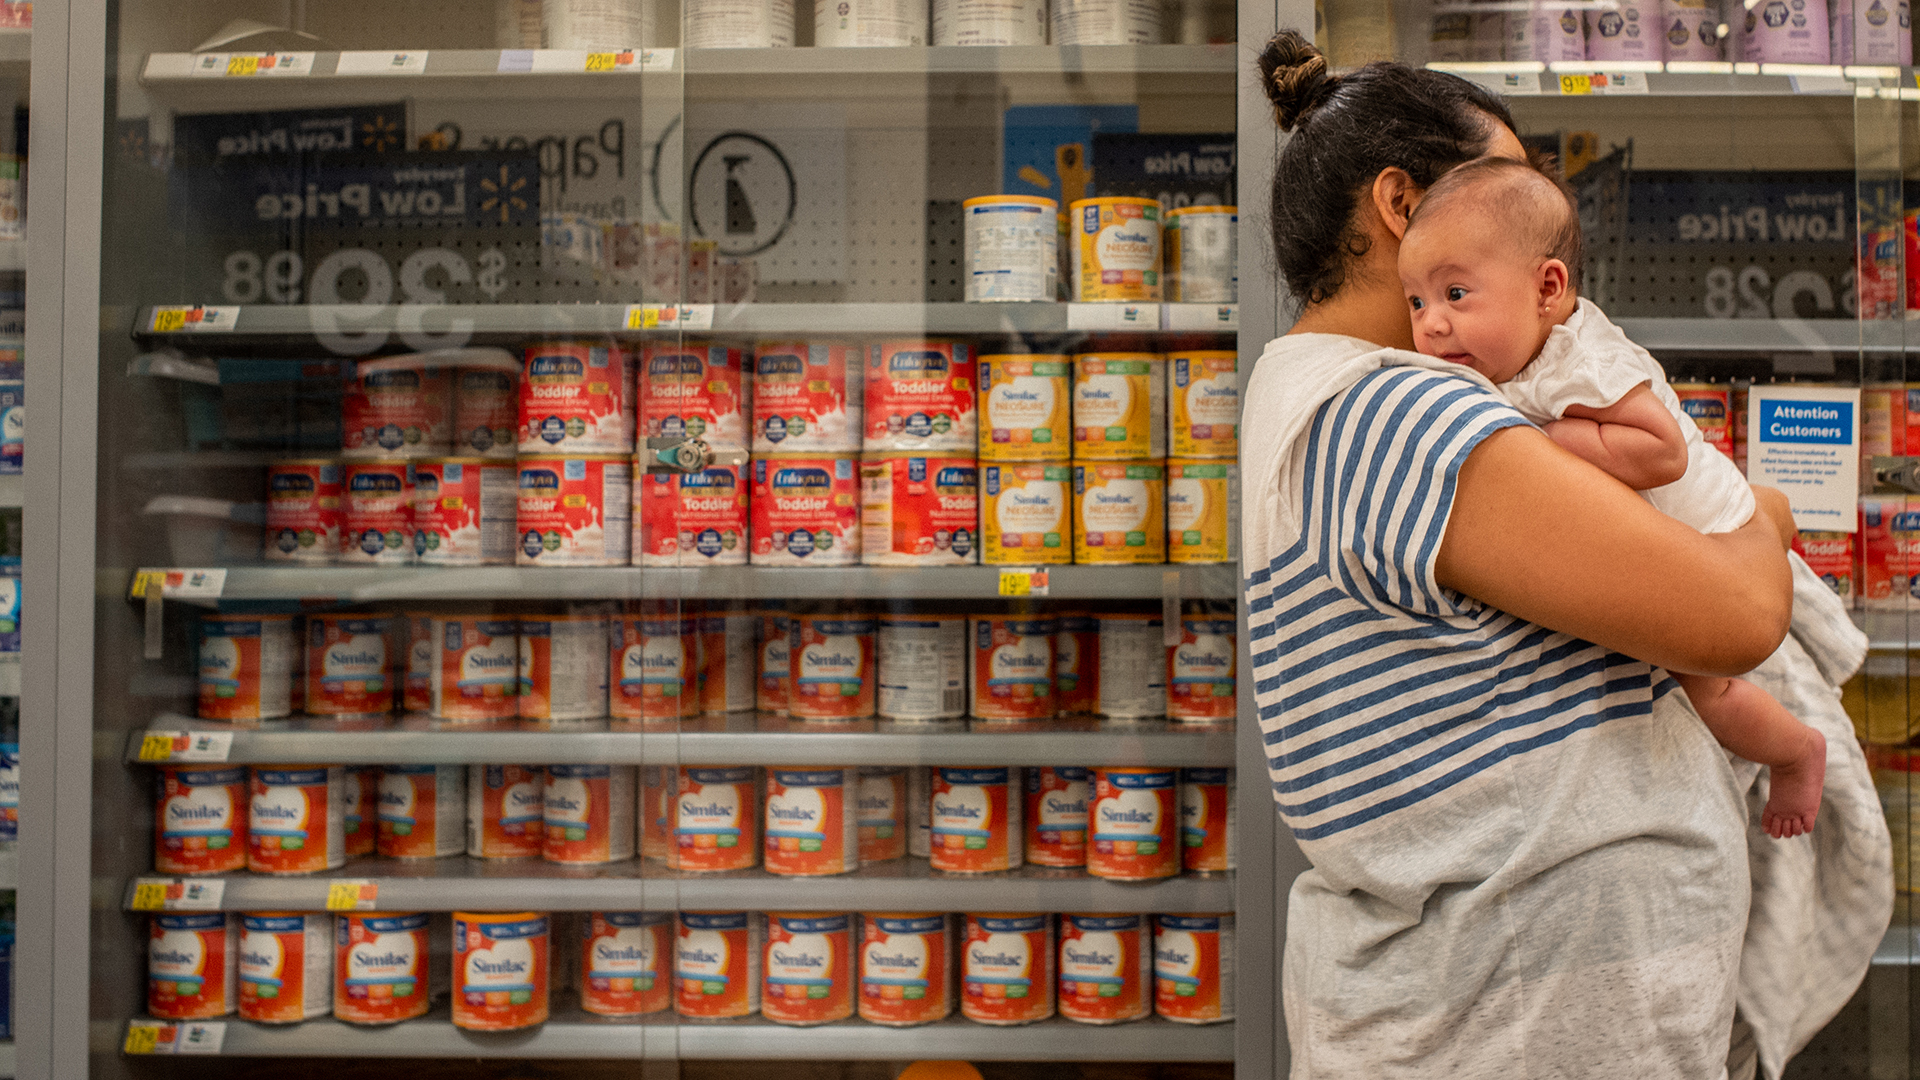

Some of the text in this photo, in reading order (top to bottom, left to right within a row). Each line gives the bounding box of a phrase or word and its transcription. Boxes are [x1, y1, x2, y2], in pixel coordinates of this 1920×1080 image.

[1562, 76, 1574, 93] 9
[531, 385, 581, 398] Toddler
[891, 381, 946, 394] Toddler
[1002, 389, 1040, 400] Similac
[1773, 404, 1839, 420] Attention
[1770, 421, 1842, 438] Customers
[683, 498, 734, 511] Toddler
[776, 498, 829, 510] Toddler
[1014, 494, 1051, 505] Similac
[1096, 493, 1133, 504] Similac
[330, 651, 379, 666] Similac
[805, 651, 856, 667] Similac
[1178, 652, 1229, 667] Similac
[170, 804, 225, 819] Similac
[681, 800, 734, 817] Similac
[769, 803, 817, 820] Similac
[934, 801, 982, 818] Similac
[1101, 806, 1154, 823] Similac
[354, 951, 408, 967] Similac
[597, 943, 649, 960] Similac
[773, 949, 824, 967] Similac
[869, 950, 920, 968] Similac
[971, 948, 1022, 966] Similac
[1065, 947, 1114, 965] Similac
[472, 957, 526, 975] Similac
